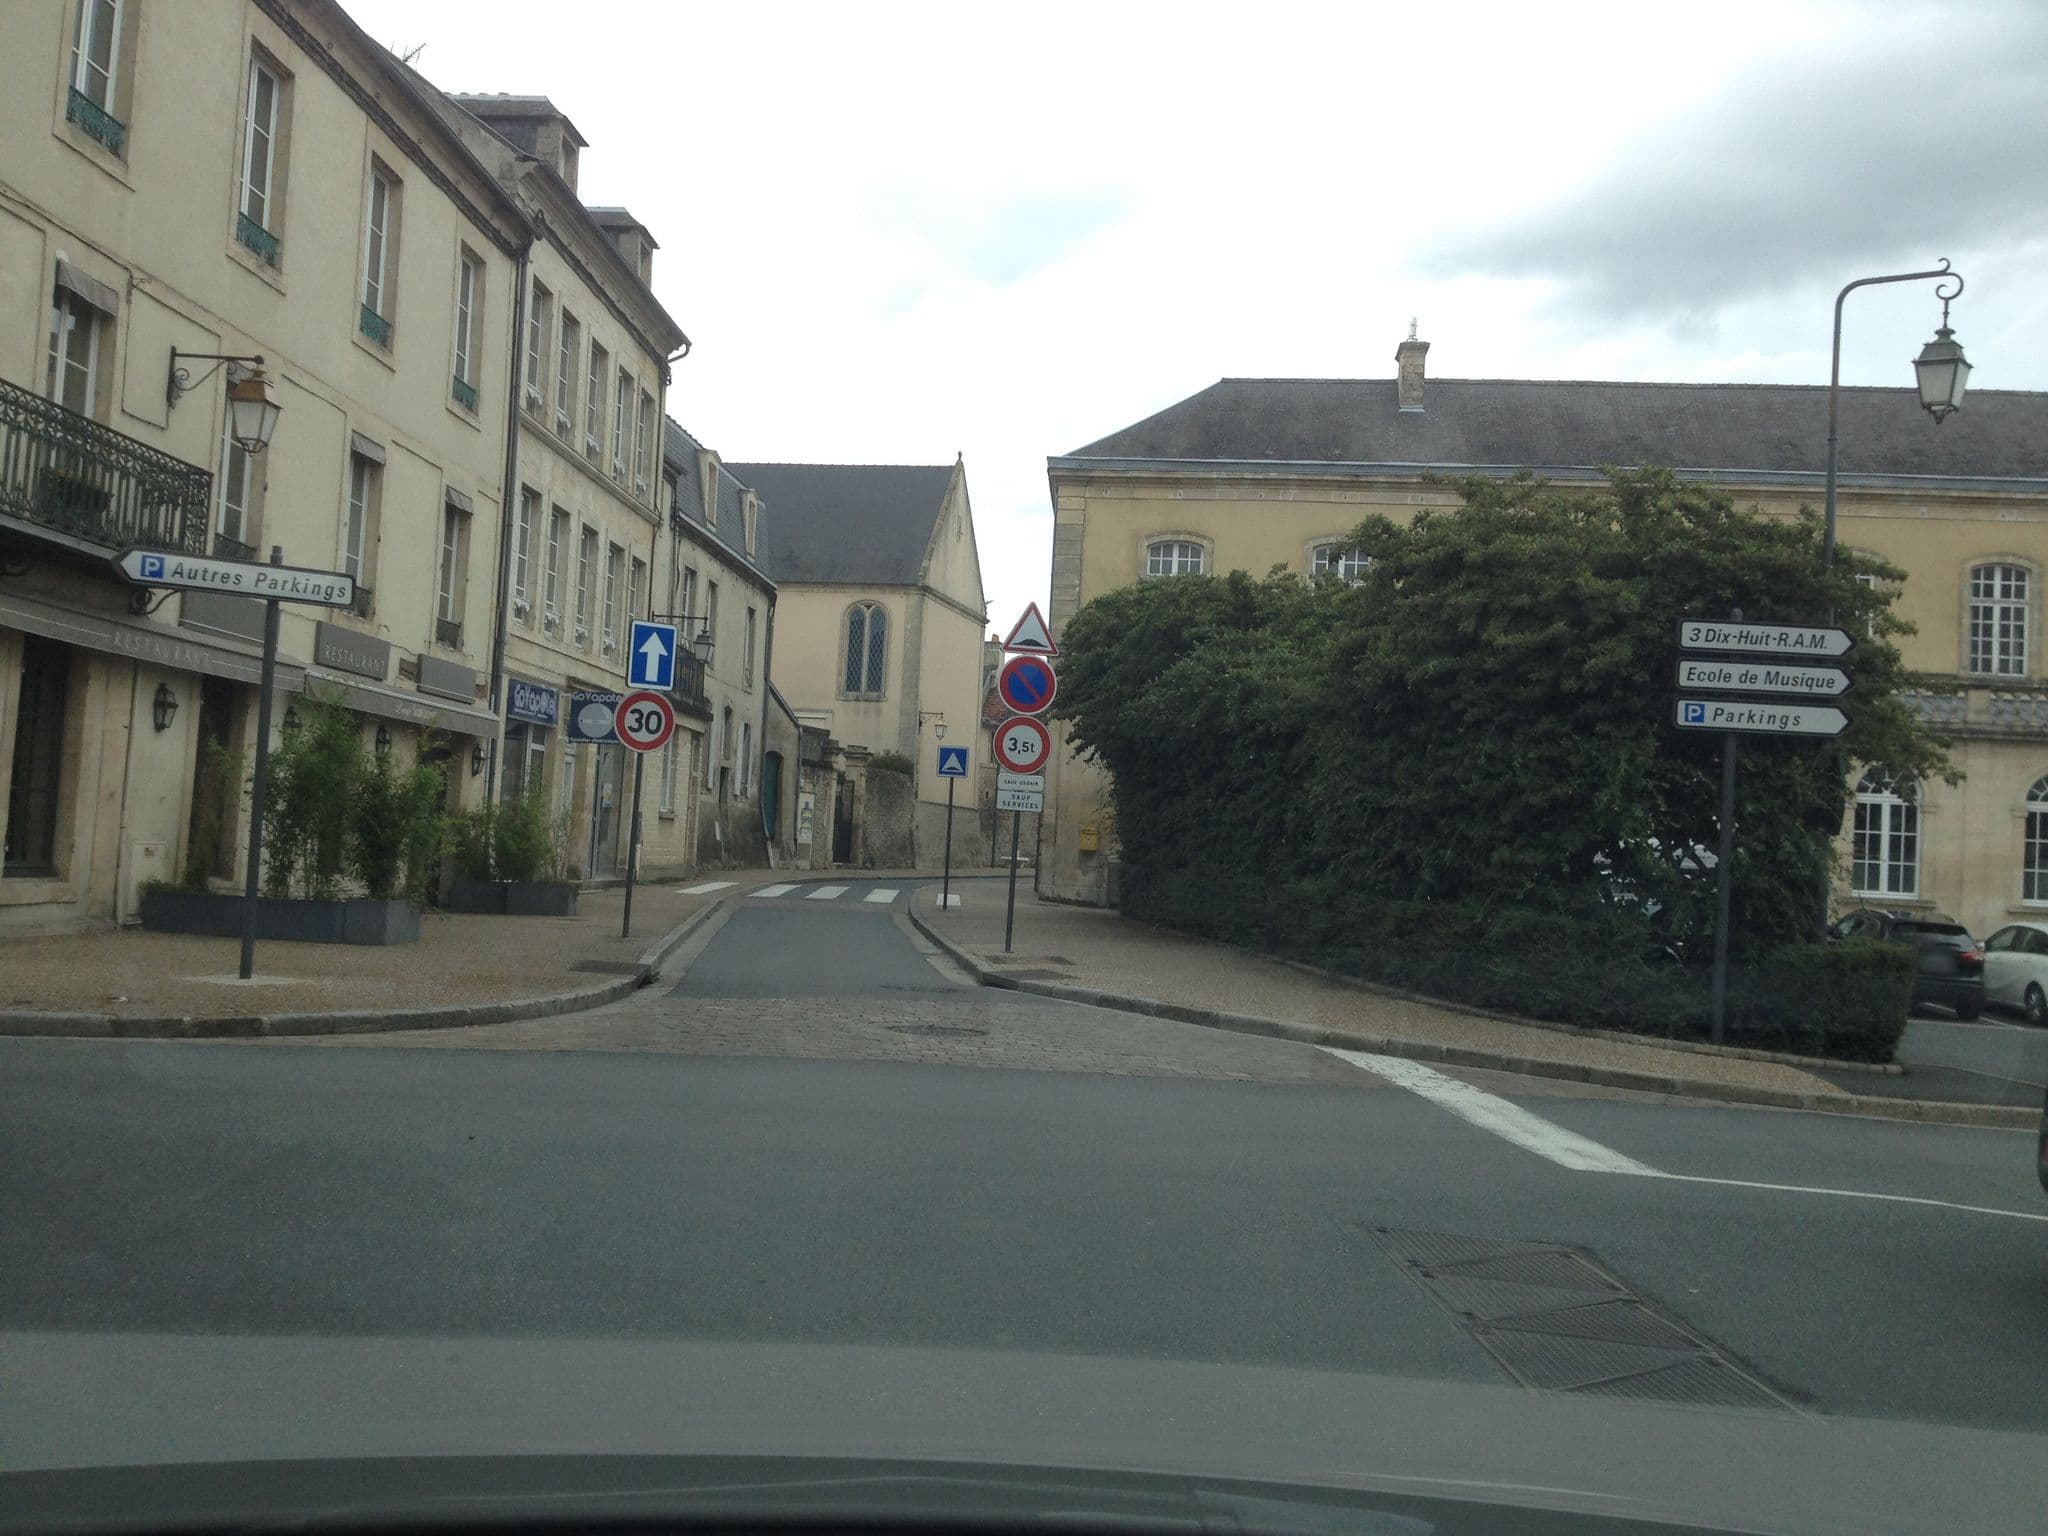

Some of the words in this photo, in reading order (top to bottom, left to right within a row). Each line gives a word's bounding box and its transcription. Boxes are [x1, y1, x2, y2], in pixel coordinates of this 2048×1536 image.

[145, 558, 160, 576] P
[172, 563, 242, 586] Autres
[255, 572, 346, 600] Parkings
[113, 631, 209, 665] RESTAURANT
[1689, 628, 1701, 642] 3
[1705, 628, 1827, 650] Dix-Huit-R.A.M.
[325, 644, 385, 672] RESTAURANT
[1687, 667, 1732, 683] Ecole
[1739, 670, 1758, 684] de
[1764, 671, 1835, 690] Musique
[628, 708, 662, 735] 30
[1688, 706, 1701, 721] P
[1713, 707, 1801, 729] Parkings
[1008, 738, 1035, 755] 3,5t
[1002, 801, 1039, 809] SERVICES
